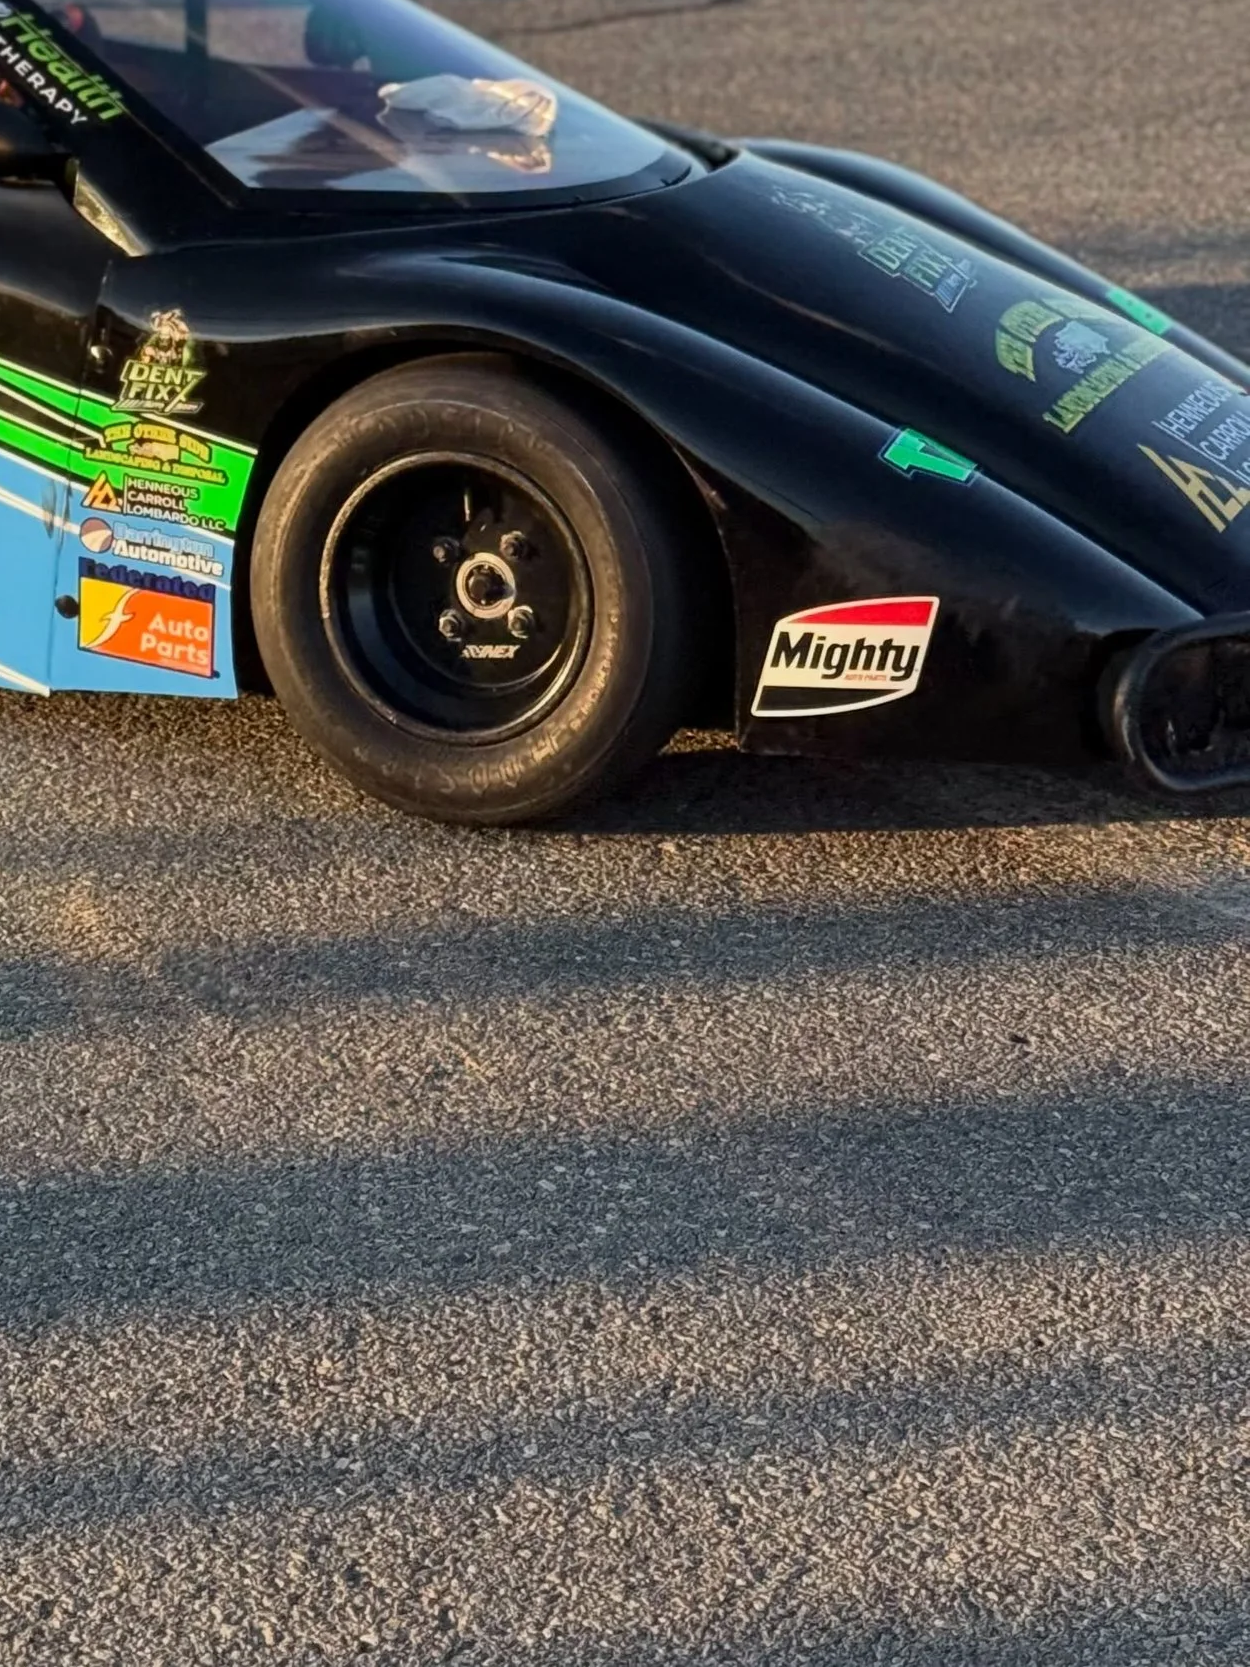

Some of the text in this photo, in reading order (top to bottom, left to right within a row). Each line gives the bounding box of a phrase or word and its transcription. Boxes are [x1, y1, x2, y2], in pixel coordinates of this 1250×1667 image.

[129, 363, 207, 385] DENT
[127, 475, 199, 499] HENNEOUS
[127, 490, 187, 511] CARROLL
[127, 503, 227, 532] LOMBARDO LLC
[113, 539, 224, 577] Automotive
[80, 556, 216, 600] Federated
[148, 613, 210, 642] Auto
[140, 632, 210, 666] Parts
[770, 631, 921, 682] Mighty
